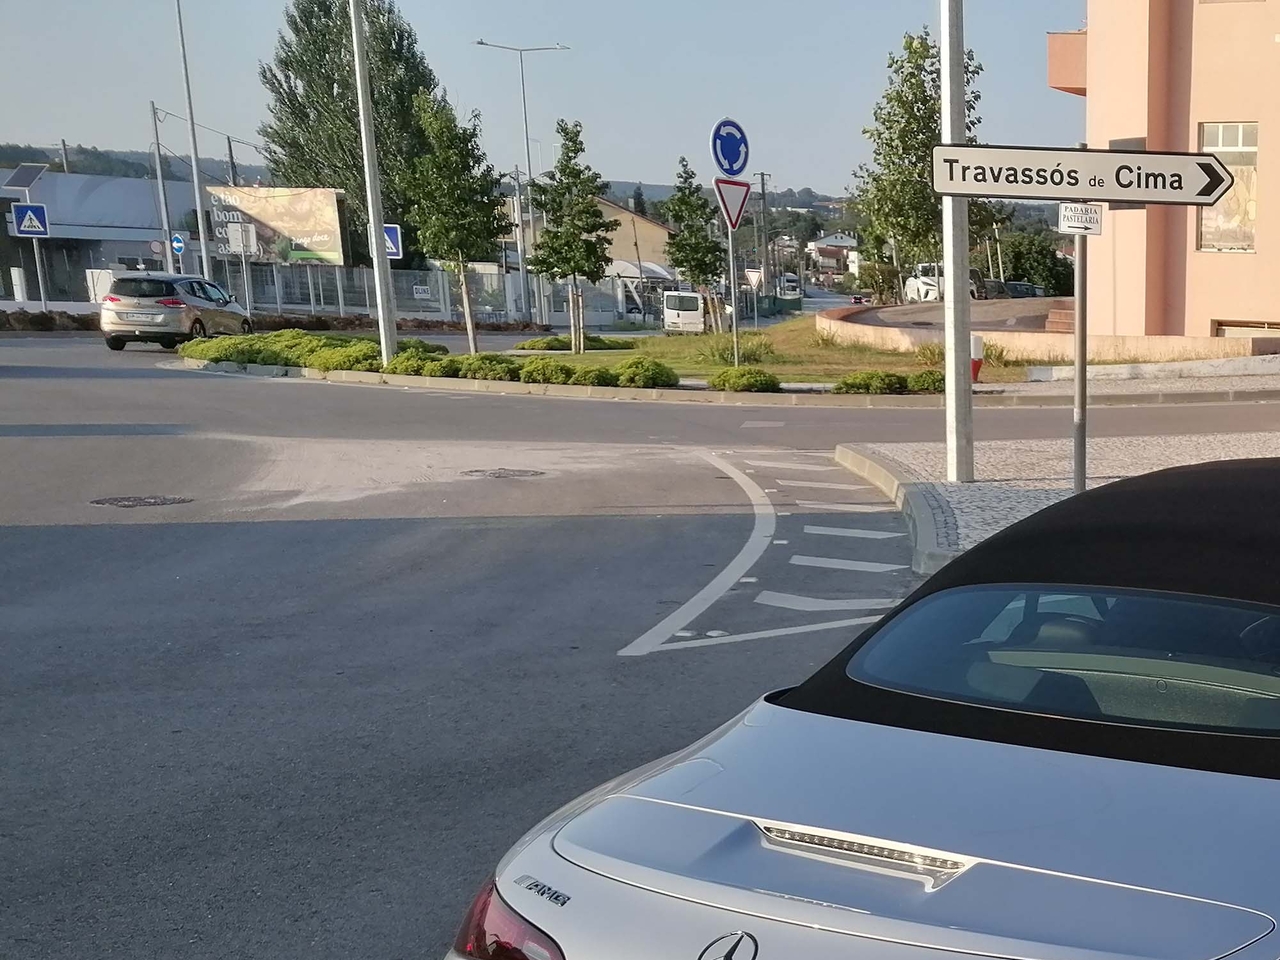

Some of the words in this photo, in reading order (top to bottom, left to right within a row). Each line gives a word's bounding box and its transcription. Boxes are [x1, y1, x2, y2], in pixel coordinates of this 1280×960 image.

[943, 158, 1079, 187] Travassós
[1088, 175, 1105, 188] de
[1115, 164, 1184, 191] Cima
[213, 207, 242, 222] bom
[1064, 206, 1098, 215] PADARIA
[1062, 214, 1099, 225] PASTELARIA
[525, 880, 571, 907] AMG
